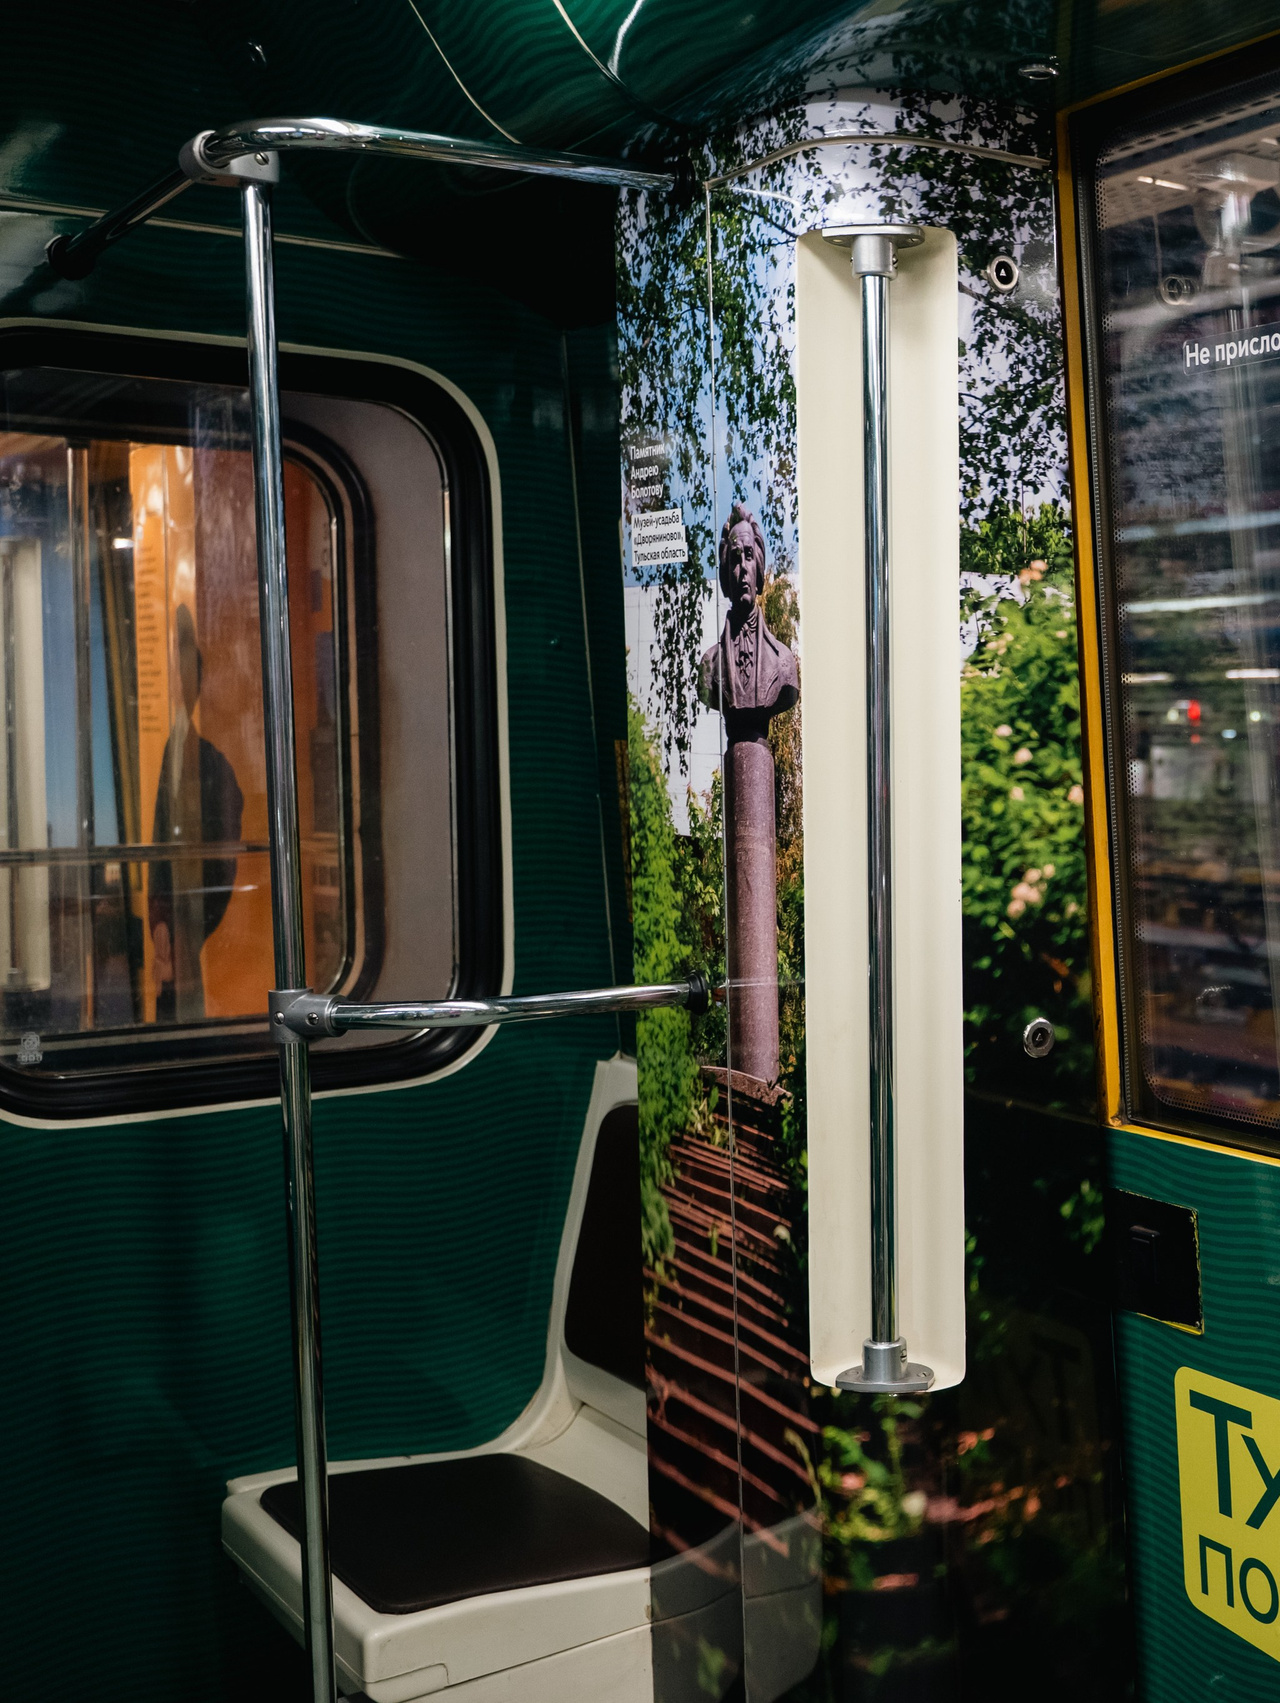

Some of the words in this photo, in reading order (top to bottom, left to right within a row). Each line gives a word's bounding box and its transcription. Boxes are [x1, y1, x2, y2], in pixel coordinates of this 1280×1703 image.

[1186, 343, 1210, 367] Не
[630, 443, 665, 460] Памятник
[630, 464, 659, 480] Андрею
[631, 483, 664, 499] Болотову
[633, 511, 680, 530] Музей-усадьба
[634, 531, 684, 546] «Дворяниново»,
[634, 550, 660, 564] Тульская
[661, 546, 686, 560] область
[1198, 1533, 1280, 1625] ПО
